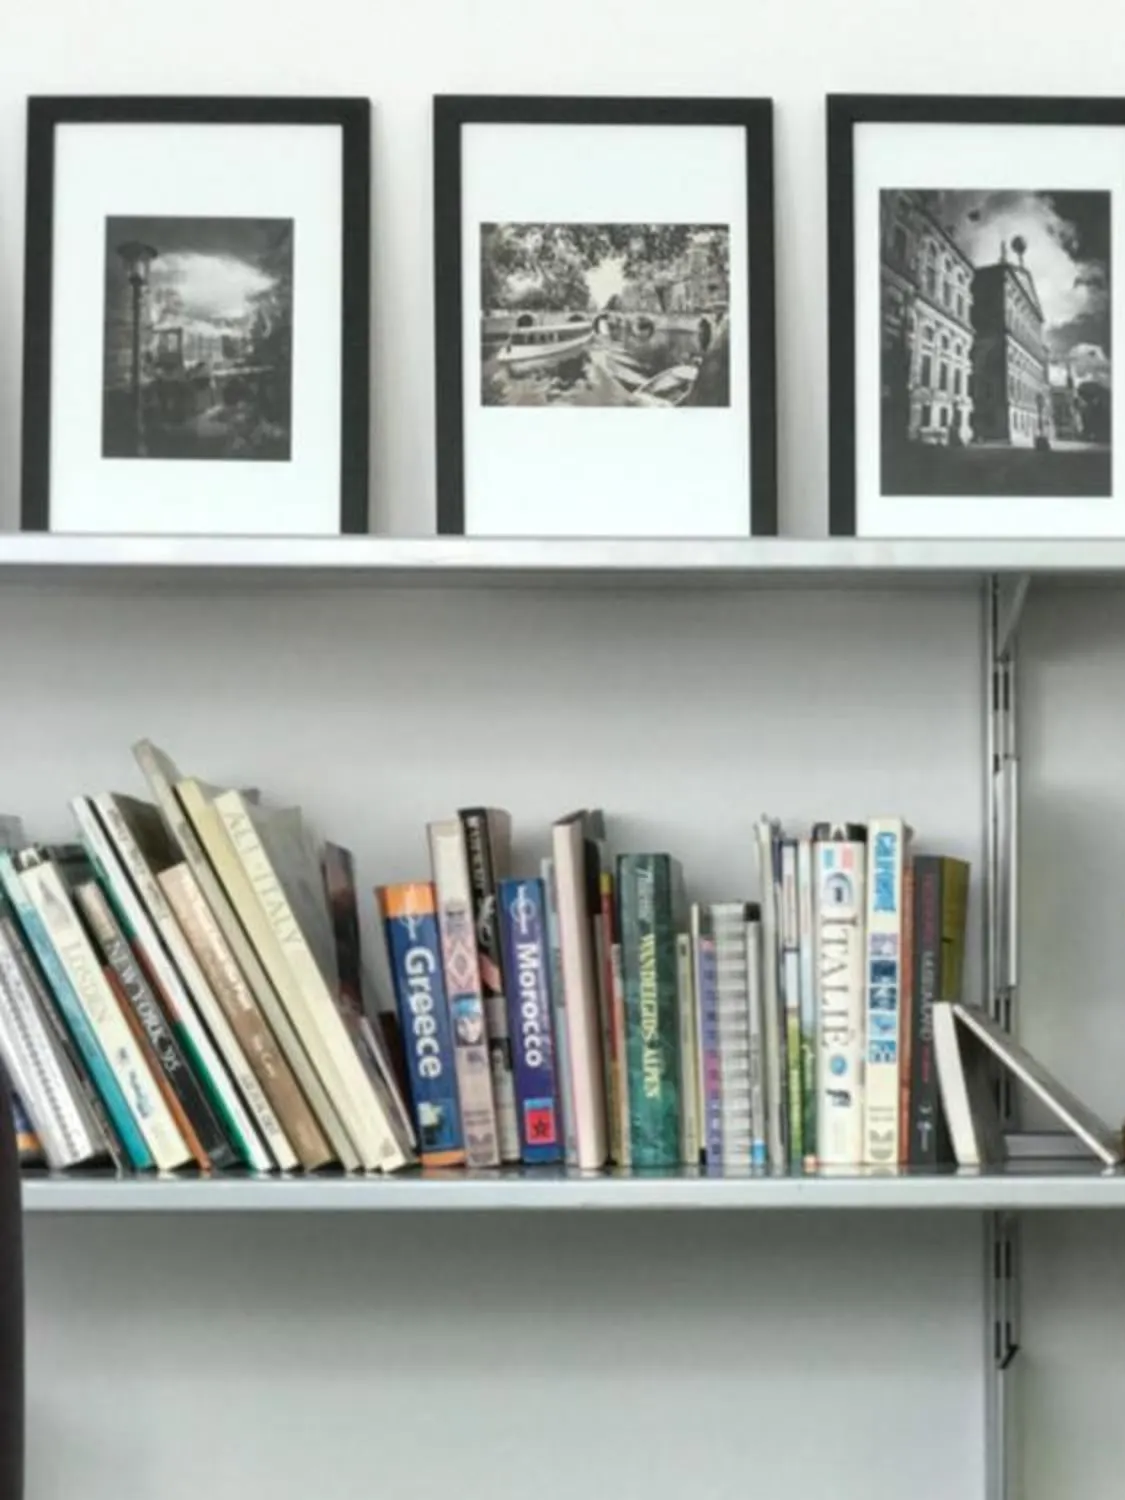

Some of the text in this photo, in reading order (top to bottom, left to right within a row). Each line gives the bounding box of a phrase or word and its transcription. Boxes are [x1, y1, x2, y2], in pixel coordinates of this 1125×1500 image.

[104, 940, 139, 984] NEW
[131, 985, 167, 1046] YORK
[404, 947, 443, 1079] Greece
[515, 942, 543, 1068] Morocco
[643, 1046, 663, 1100] ALPEN
